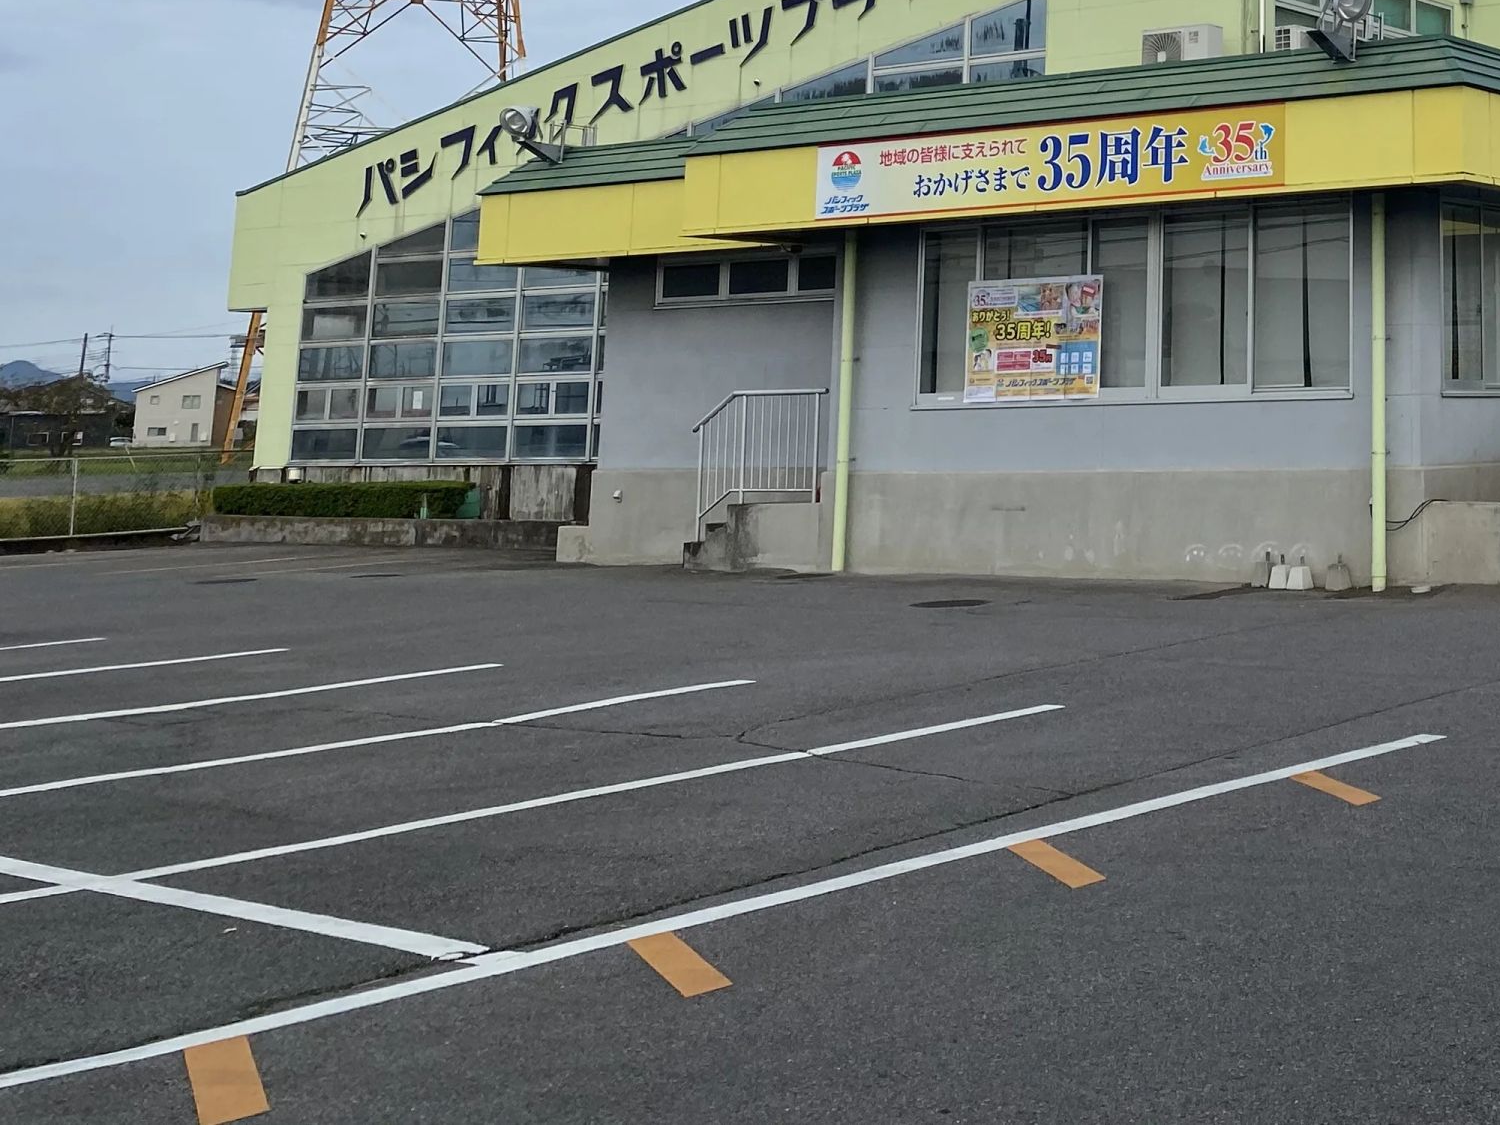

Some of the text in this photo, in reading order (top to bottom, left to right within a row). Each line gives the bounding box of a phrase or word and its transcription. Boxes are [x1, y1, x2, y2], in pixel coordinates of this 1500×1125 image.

[880, 138, 1028, 166] 地域の皆様に支えられて
[913, 126, 1190, 198] おかげさまで 35周年
[1204, 163, 1271, 176] Anniversary
[824, 194, 864, 205] パシフィック
[820, 203, 870, 214] スポーツプラザ
[971, 309, 1011, 323] ありがとう!
[995, 320, 1052, 341] 35周年!
